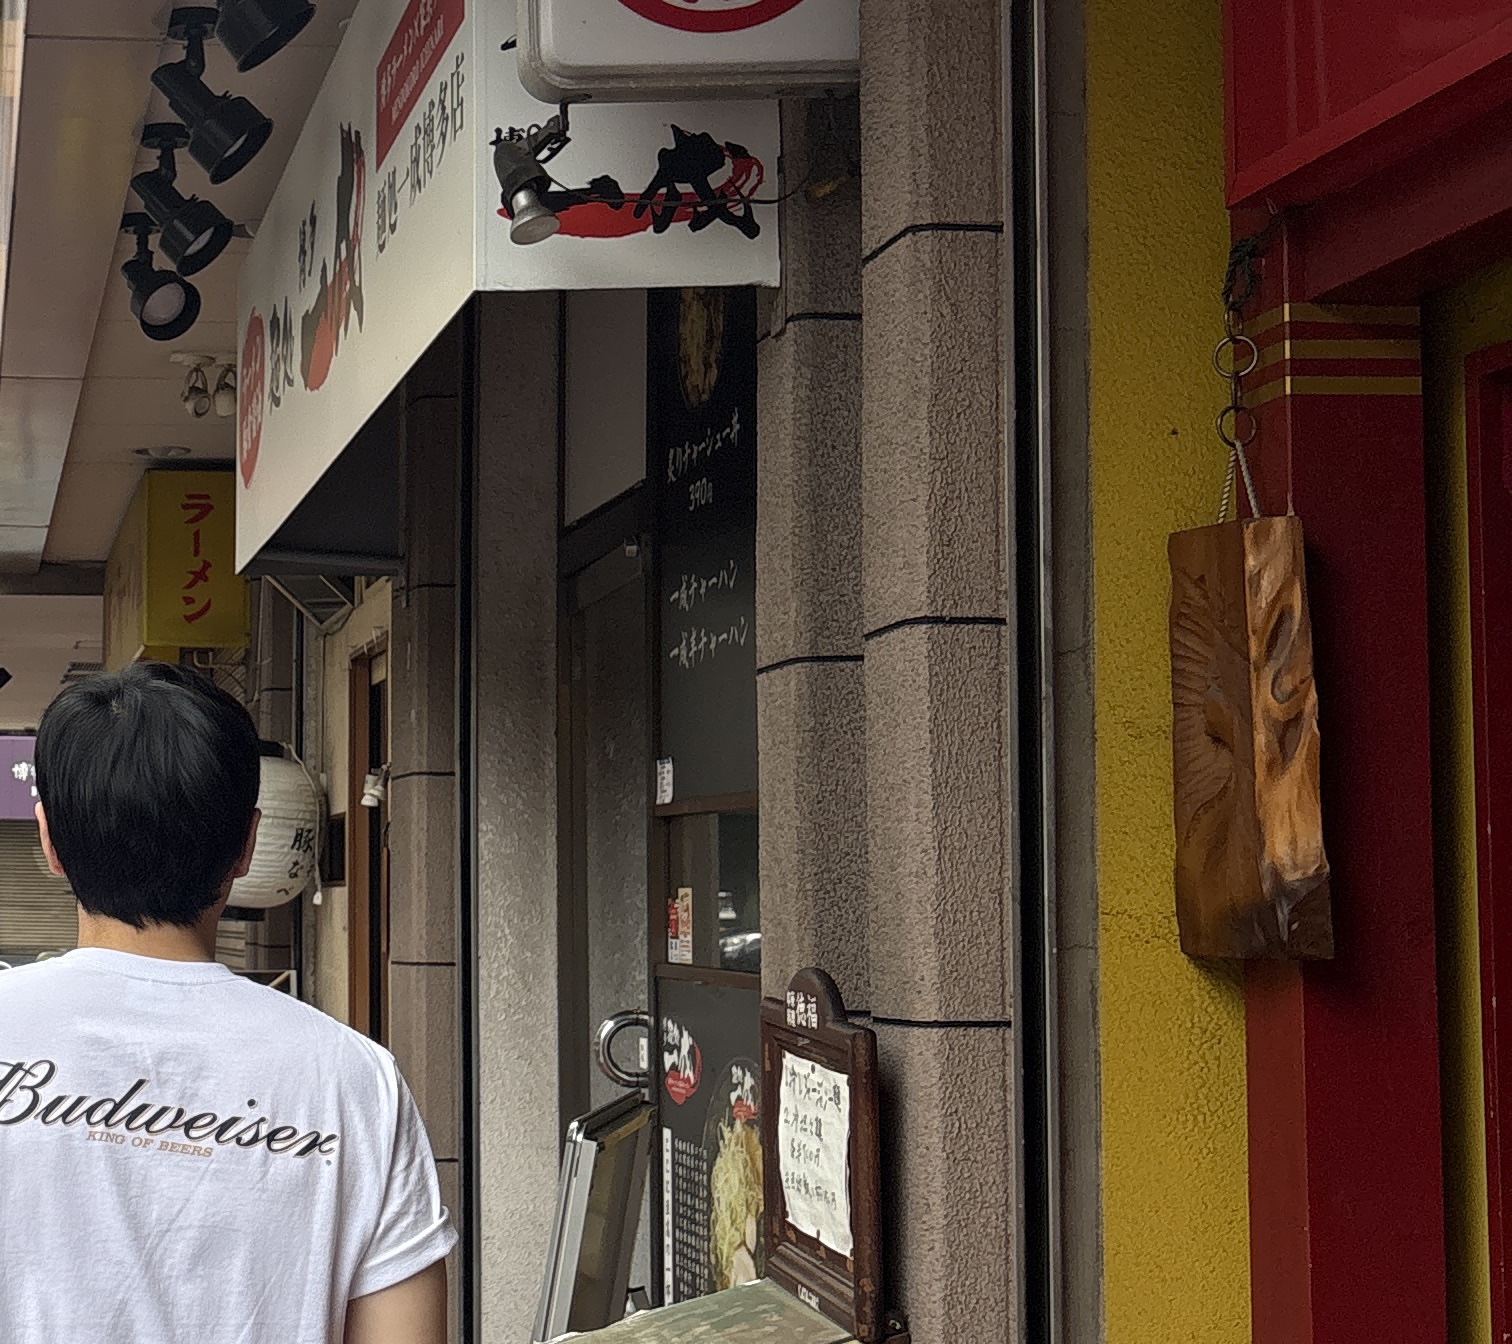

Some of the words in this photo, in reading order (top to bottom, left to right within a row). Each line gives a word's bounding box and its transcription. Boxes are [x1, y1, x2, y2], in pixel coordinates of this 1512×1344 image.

[180, 493, 215, 624] ラーメン
[86, 1130, 125, 1145] KING
[131, 1136, 154, 1149] OF
[157, 1140, 214, 1158] BEERS
